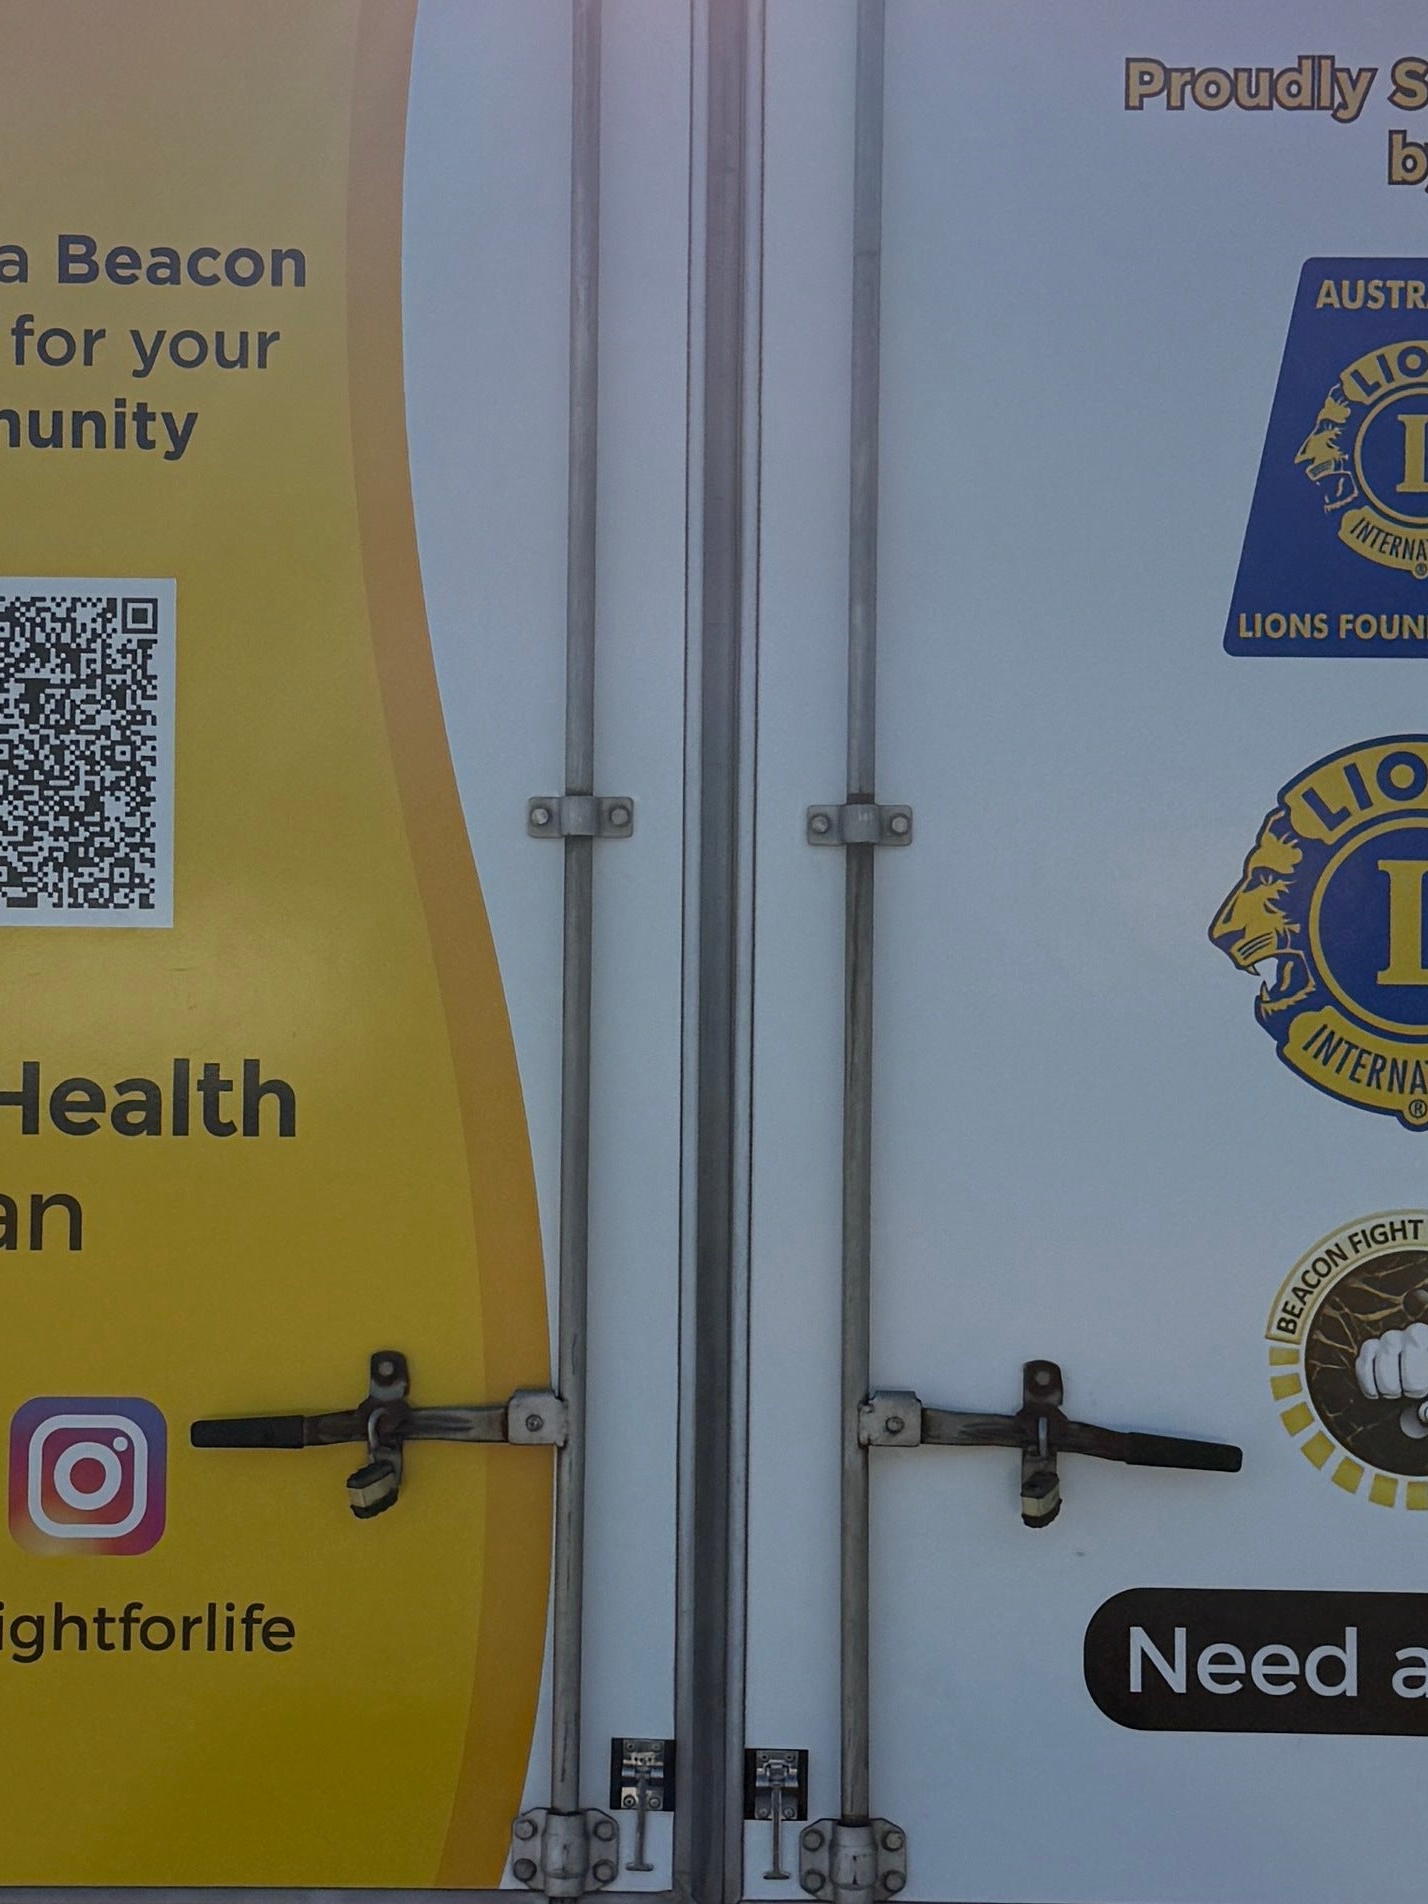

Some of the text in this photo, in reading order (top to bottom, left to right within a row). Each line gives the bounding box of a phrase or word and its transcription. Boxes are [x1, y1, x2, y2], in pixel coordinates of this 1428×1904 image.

[1125, 54, 1376, 124] Proudly
[57, 234, 306, 287] Beacon
[11, 314, 106, 367] for
[129, 328, 280, 378] your
[1239, 612, 1328, 639] LIONS
[1277, 1242, 1348, 1335] BEACON
[1348, 1219, 1424, 1255] FIGHT
[1128, 1626, 1358, 1697] Need
